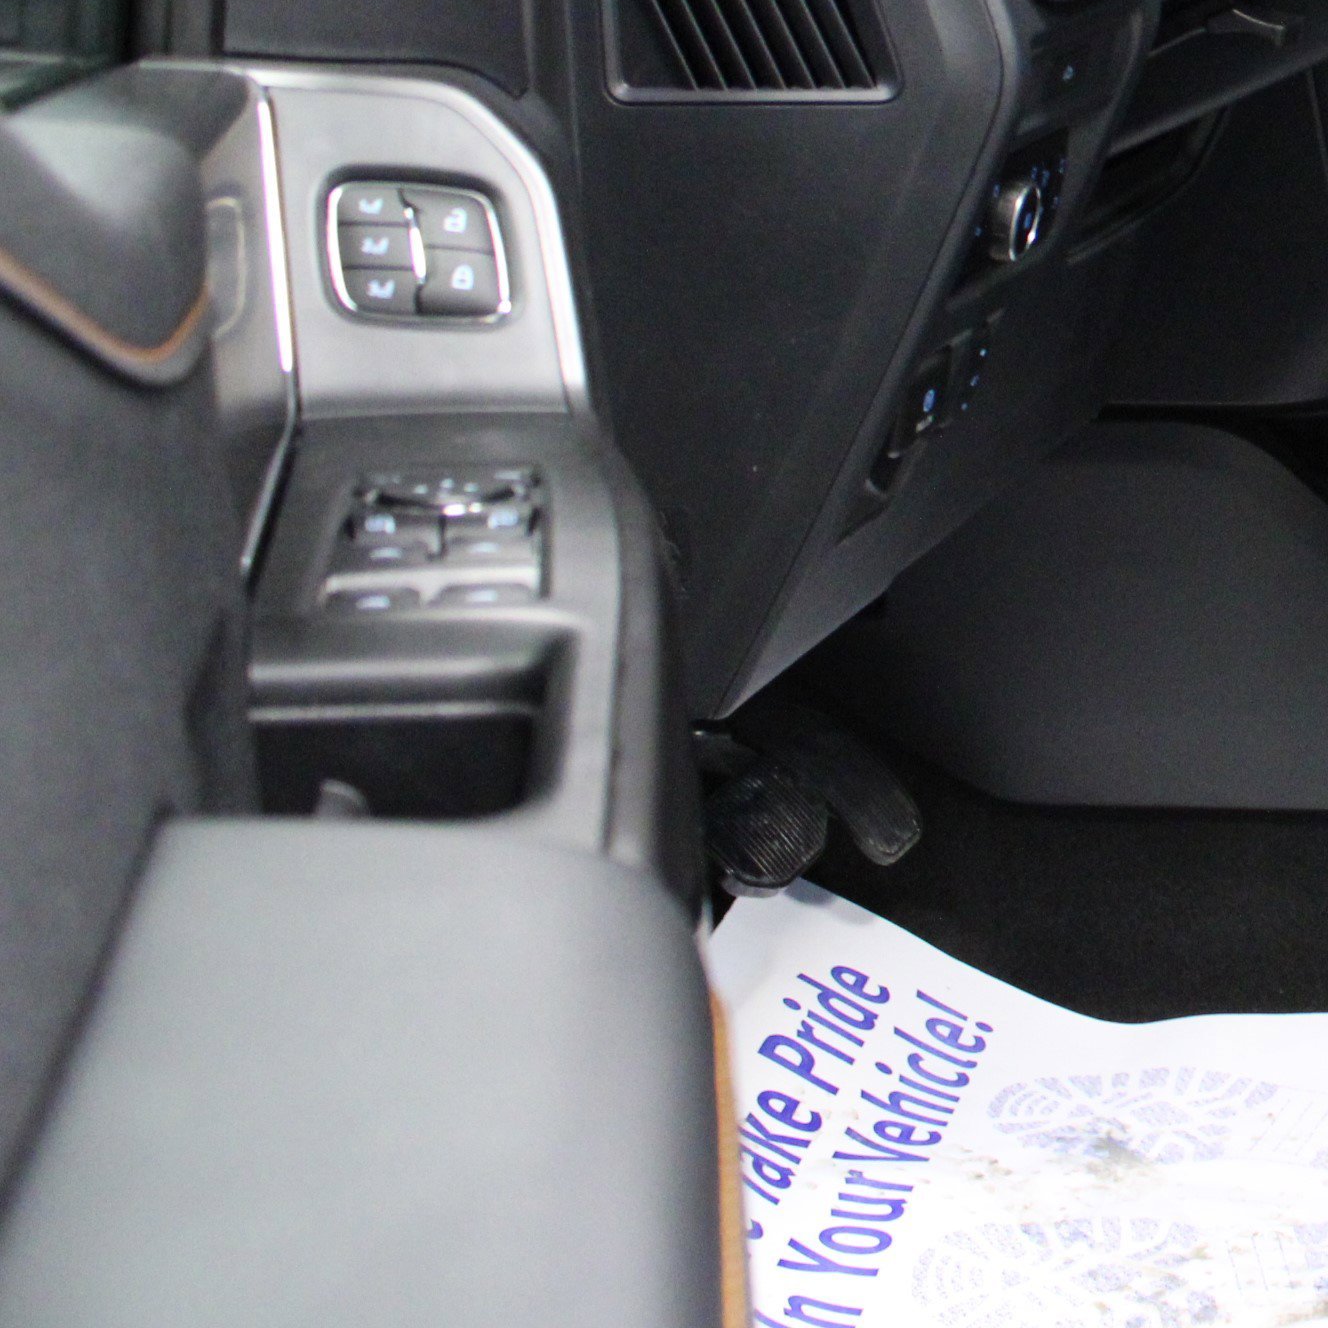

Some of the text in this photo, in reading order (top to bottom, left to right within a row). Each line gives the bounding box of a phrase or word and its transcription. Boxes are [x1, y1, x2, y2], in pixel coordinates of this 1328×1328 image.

[757, 964, 891, 1096] Pride
[832, 988, 994, 1163] Vehicle!
[776, 1168, 914, 1277] Your
